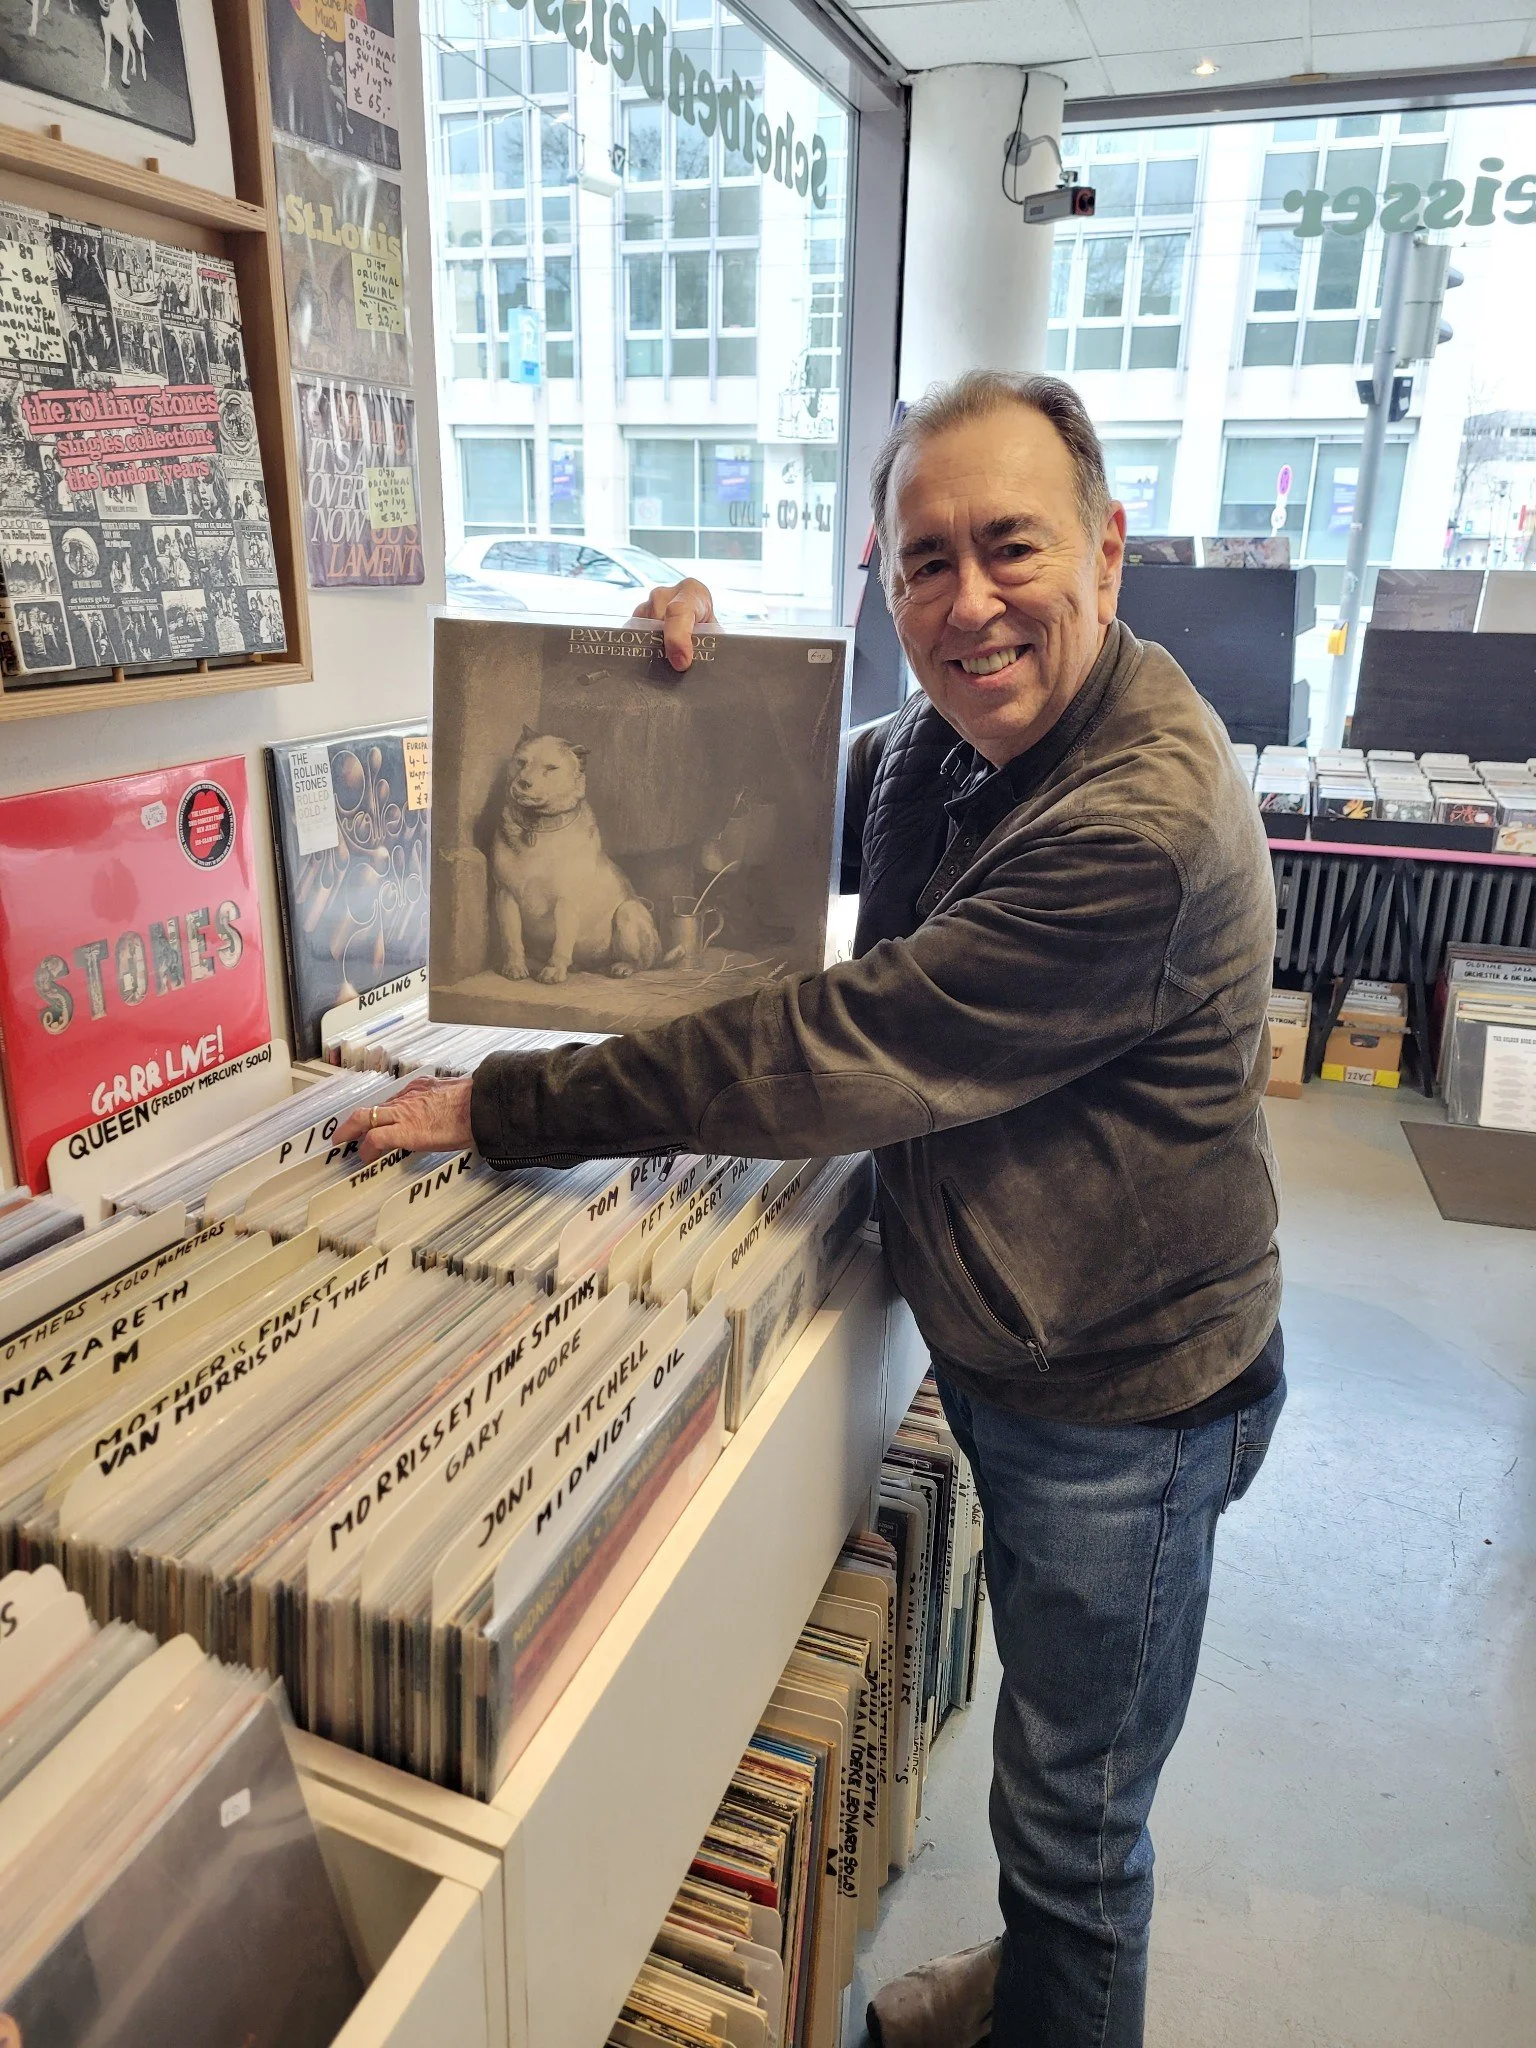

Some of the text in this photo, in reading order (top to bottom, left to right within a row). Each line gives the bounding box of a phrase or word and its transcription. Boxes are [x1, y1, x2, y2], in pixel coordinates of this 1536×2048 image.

[315, 7, 337, 32] Much
[348, 33, 396, 63] ORIGINAL
[356, 48, 390, 74] SWIRL
[357, 269, 400, 287] ORIGINAL
[362, 281, 395, 300] SWIRL
[21, 389, 219, 425] the rolling stones
[57, 431, 125, 461] singles
[65, 467, 99, 492] the
[99, 464, 162, 488] london
[163, 461, 211, 485] years
[310, 506, 368, 544] NOW
[326, 543, 422, 578] LAMENT
[569, 643, 653, 659] PAMPERED
[692, 636, 717, 649] OG
[291, 752, 308, 766] THE
[294, 762, 329, 780] ROLLING
[295, 776, 328, 793] STONES
[297, 789, 329, 807] ROLLED
[34, 899, 244, 1036] STONES
[359, 976, 411, 1011] ROLLING
[90, 1024, 226, 1116] GRRR LIVE!
[68, 1043, 272, 1160] QUEEN (FREDDY MERCURY SOLO)
[279, 1142, 292, 1164] P
[348, 1163, 379, 1189] THE
[409, 1151, 472, 1204] PINK
[587, 1186, 619, 1222] TOM
[641, 1167, 696, 1238] PET SHOP
[679, 1183, 723, 1243] ROBERT
[731, 1173, 801, 1270] RANDY NEWMAN
[3, 1280, 189, 1405] NAZARETH
[5, 1301, 86, 1361] OTHERS
[94, 1275, 339, 1459] MOTHER'S FINEST
[99, 1422, 160, 1477] VAN
[174, 1324, 301, 1426] MORRISON
[328, 1256, 390, 1311] THEM
[112, 1339, 140, 1374] M
[329, 1387, 475, 1552] MORRISSEY
[530, 1270, 598, 1350] SMITHS
[445, 1328, 582, 1485] GARY MOORE
[478, 1340, 649, 1549] JONI MITCHELL
[535, 1348, 685, 1536] MIDNIGT OIL
[845, 1788, 862, 1857] LEONARD
